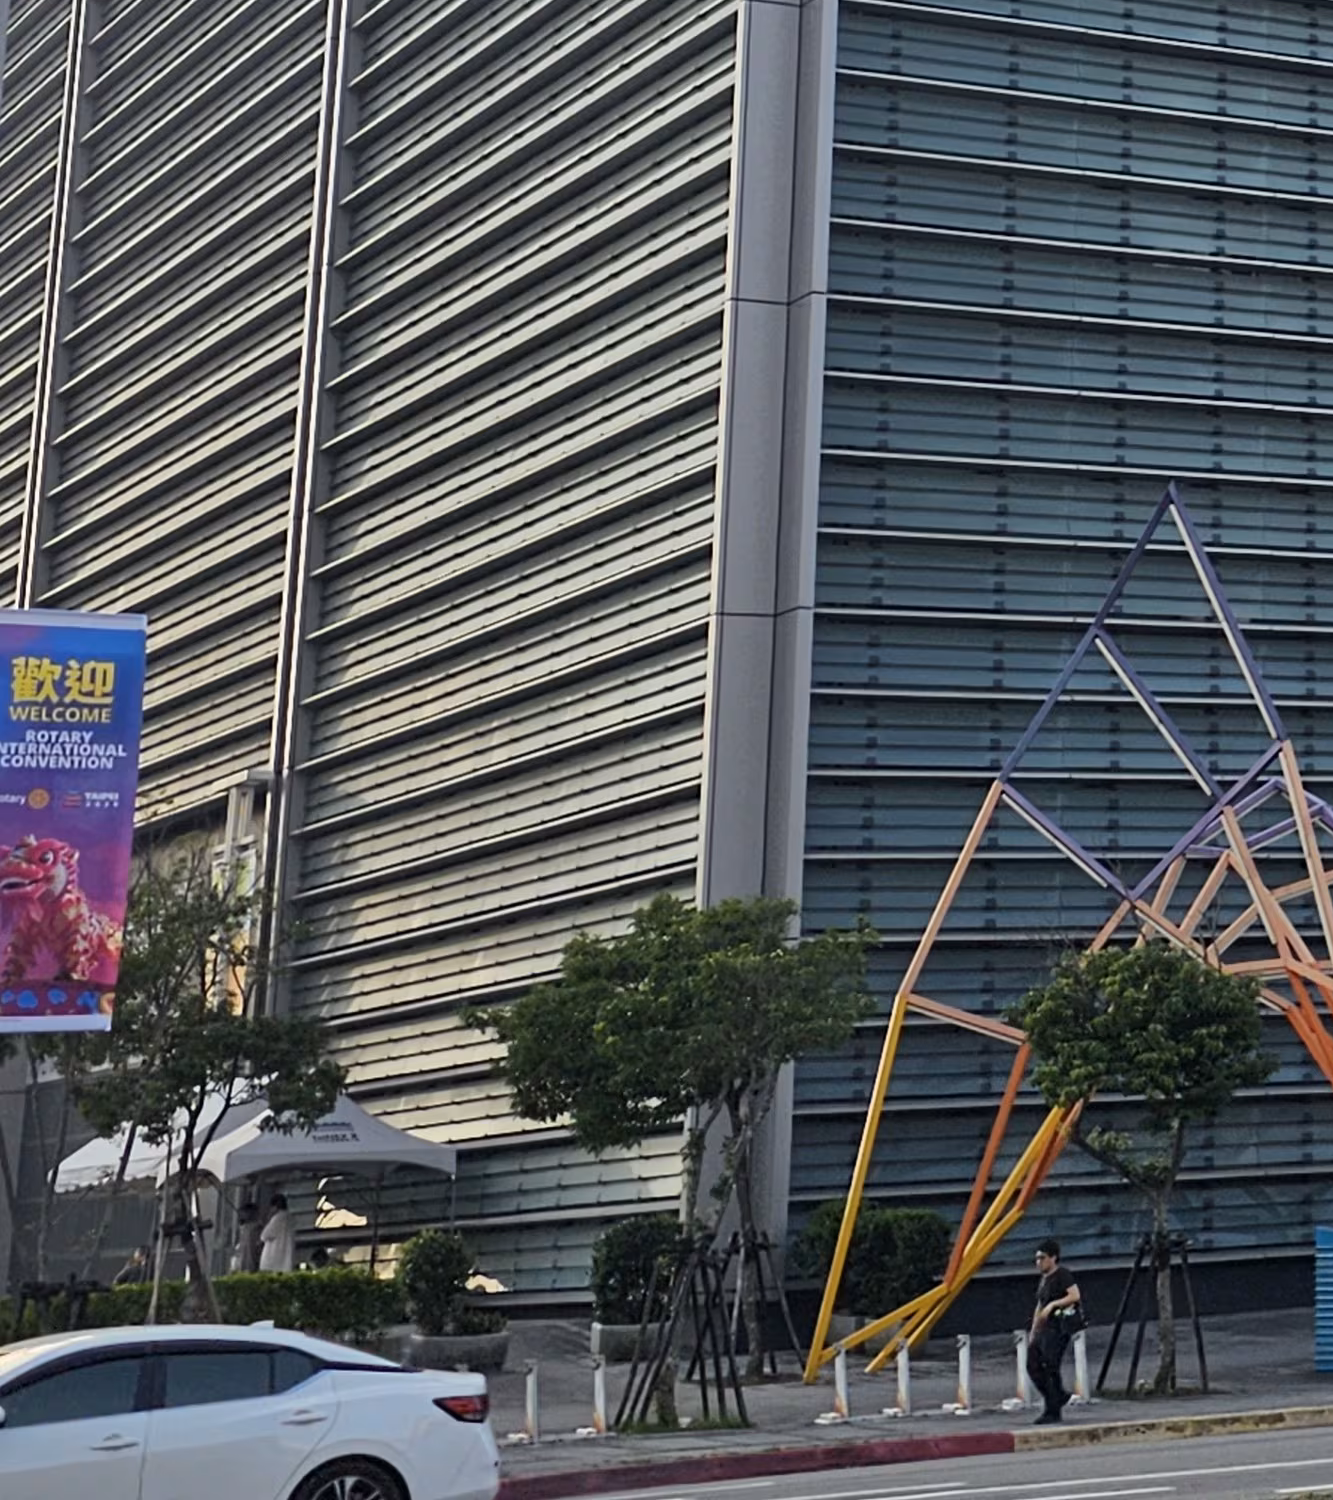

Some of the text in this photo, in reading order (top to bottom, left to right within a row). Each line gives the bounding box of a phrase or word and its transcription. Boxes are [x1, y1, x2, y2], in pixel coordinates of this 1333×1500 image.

[11, 656, 116, 705] 歡迎
[9, 706, 112, 724] WELCOME
[25, 729, 94, 744] ROTARY
[0, 741, 128, 758] NTERNATIONAL
[0, 755, 114, 769] CONVENTION
[84, 791, 119, 801] TAIPEI
